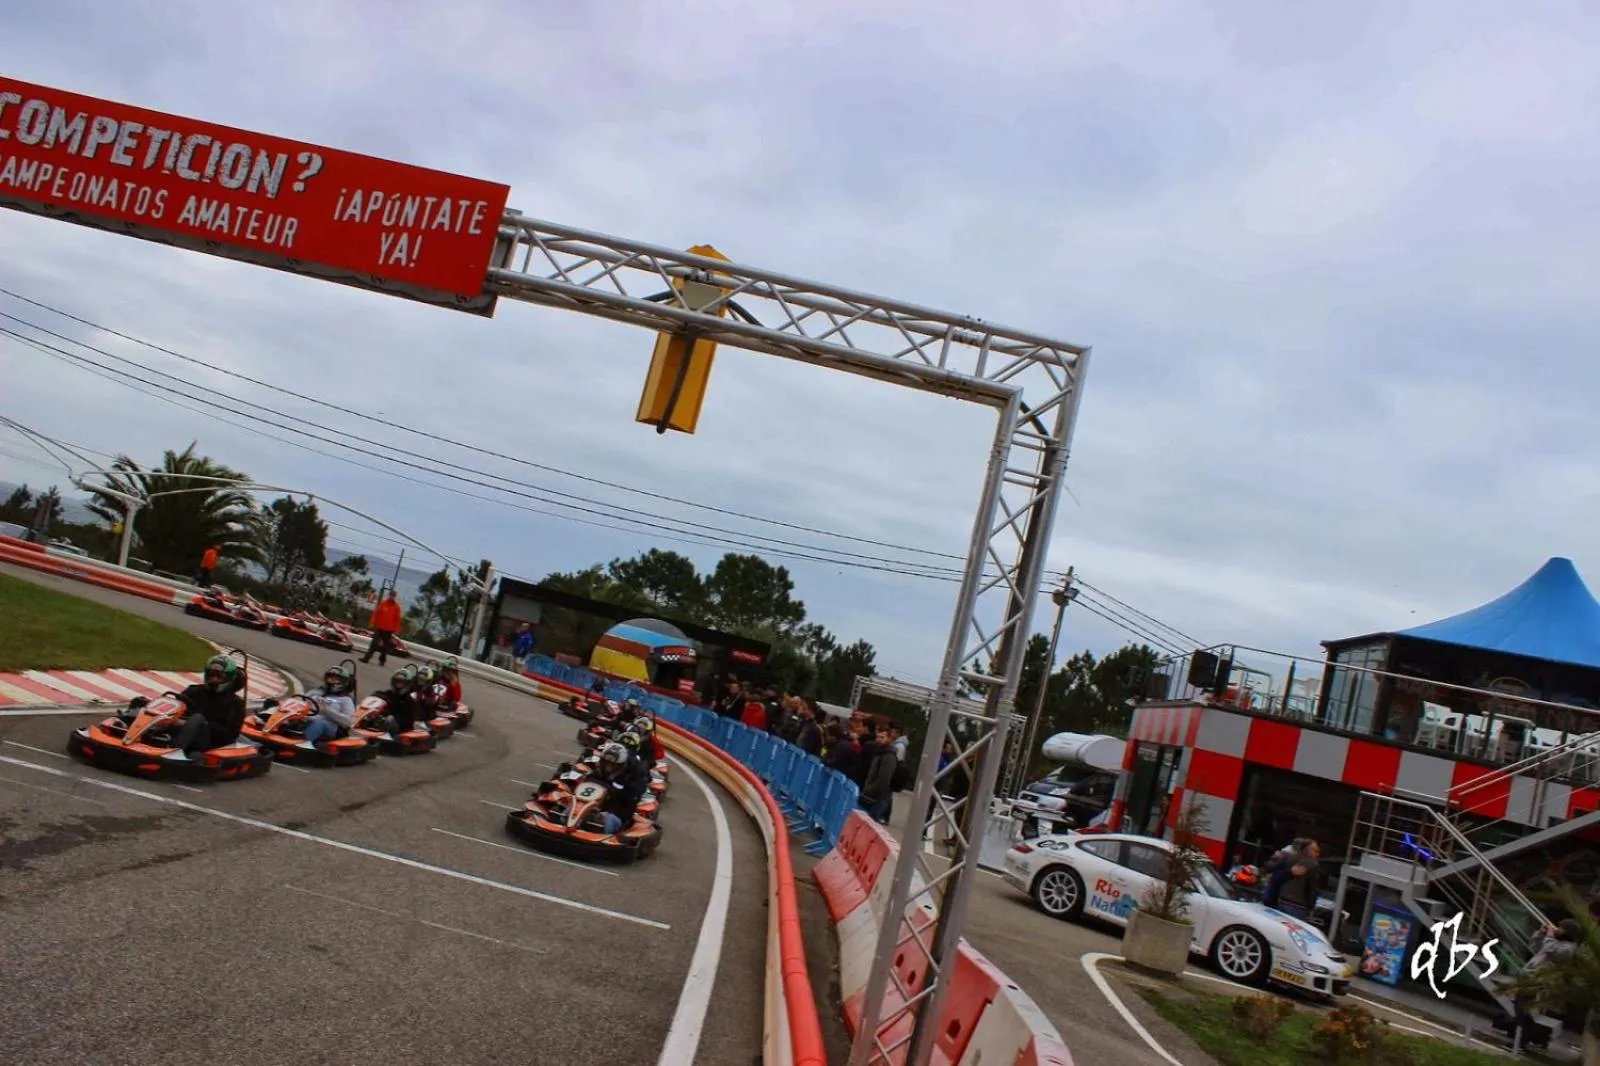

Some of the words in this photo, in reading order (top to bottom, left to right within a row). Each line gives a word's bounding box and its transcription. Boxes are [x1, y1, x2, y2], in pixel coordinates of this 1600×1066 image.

[0, 92, 323, 198] COMPETICION?
[0, 155, 168, 219] AMPEONATOS
[177, 195, 298, 248] AMATEUR
[378, 231, 422, 268] YA!
[580, 786, 597, 798] 8
